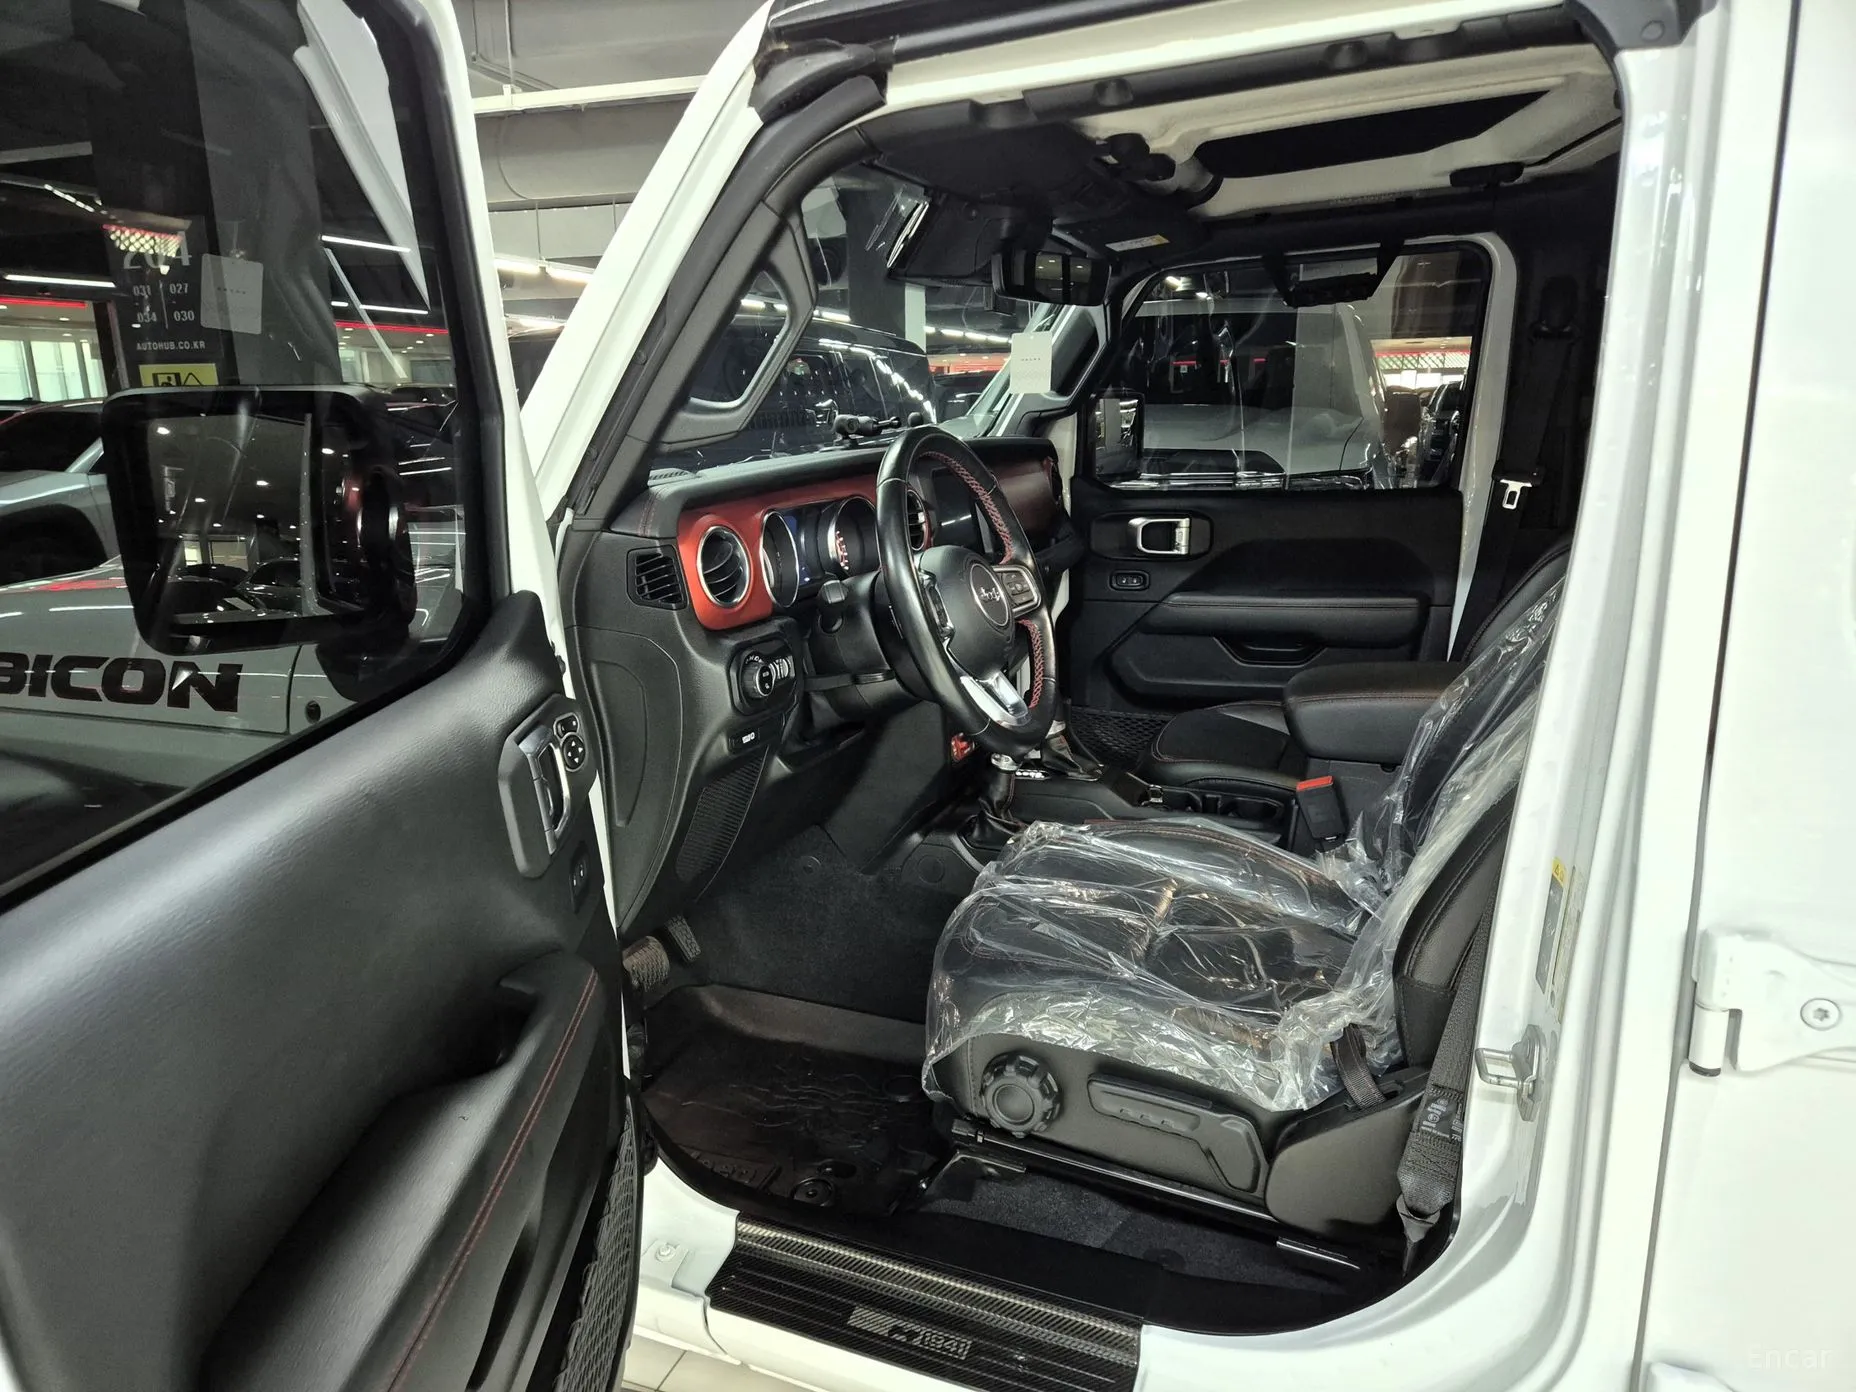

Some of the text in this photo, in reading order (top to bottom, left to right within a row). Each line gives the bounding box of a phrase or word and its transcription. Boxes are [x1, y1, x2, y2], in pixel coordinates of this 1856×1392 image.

[169, 283, 189, 294] 027
[173, 310, 195, 322] 030
[136, 340, 206, 351] AUTOHUB.CO.KR
